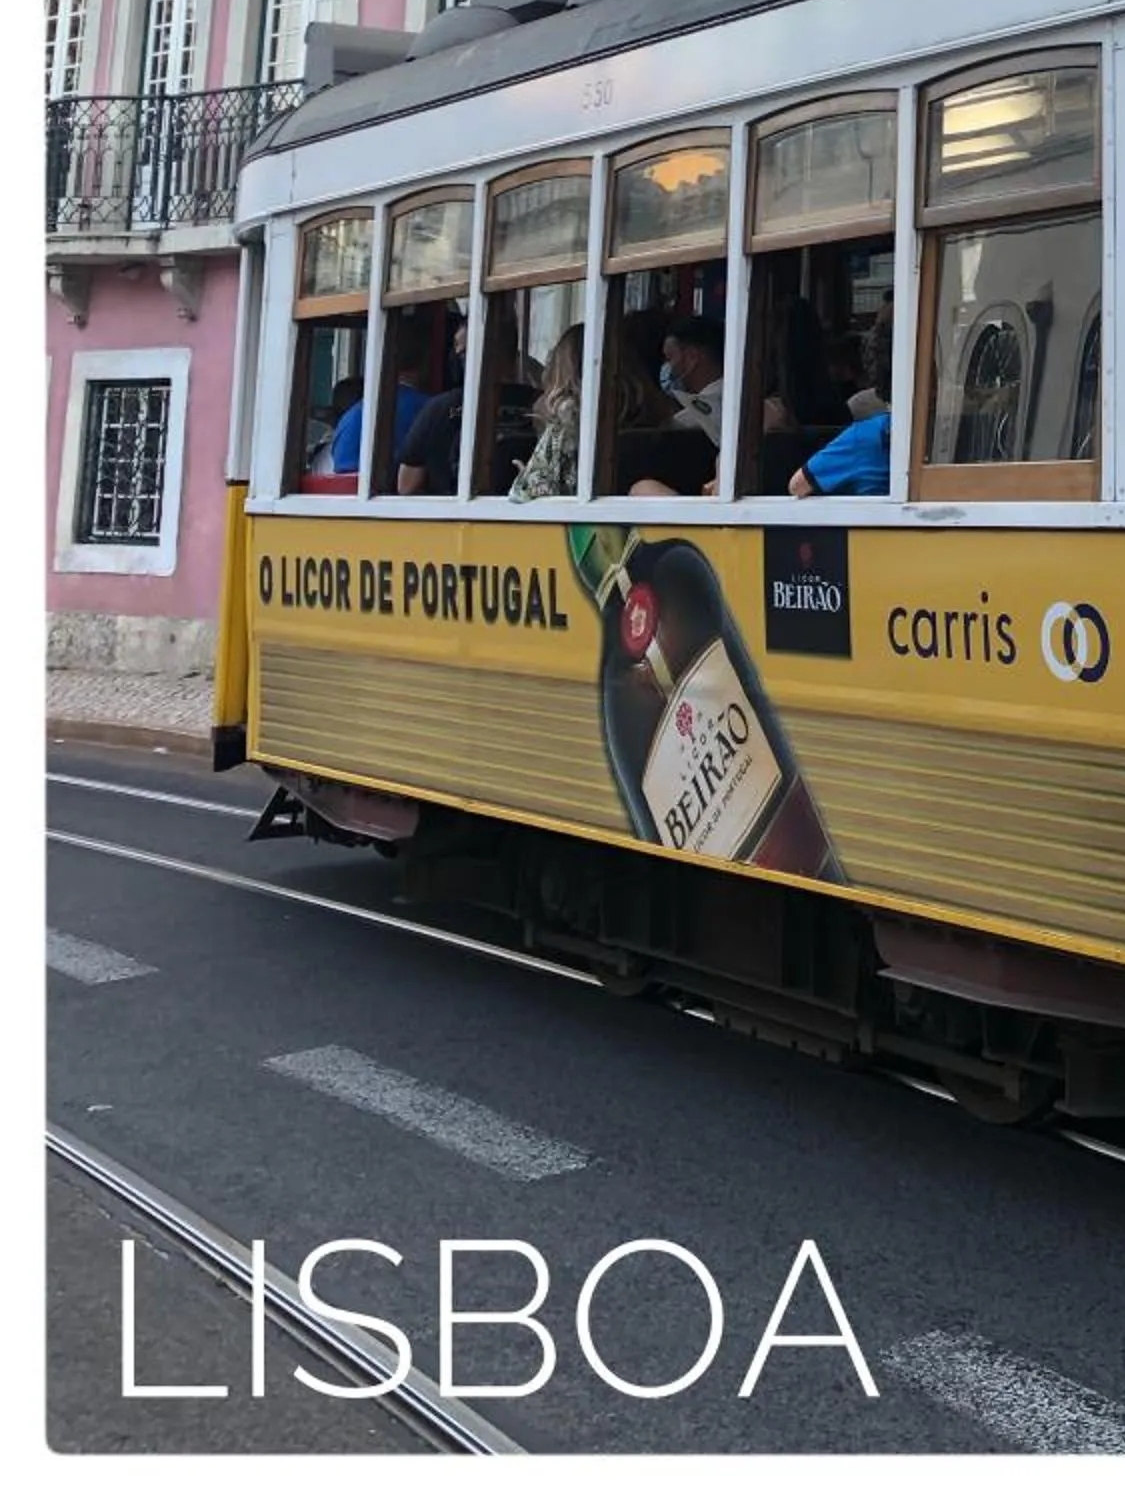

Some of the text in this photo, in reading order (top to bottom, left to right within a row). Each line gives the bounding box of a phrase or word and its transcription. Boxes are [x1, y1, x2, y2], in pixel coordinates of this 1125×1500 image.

[260, 555, 569, 630] O LICOR DE PORTUGAL
[773, 580, 841, 612] BEIRÃO
[888, 591, 1017, 665] carris
[664, 702, 749, 850] BEIRÃO
